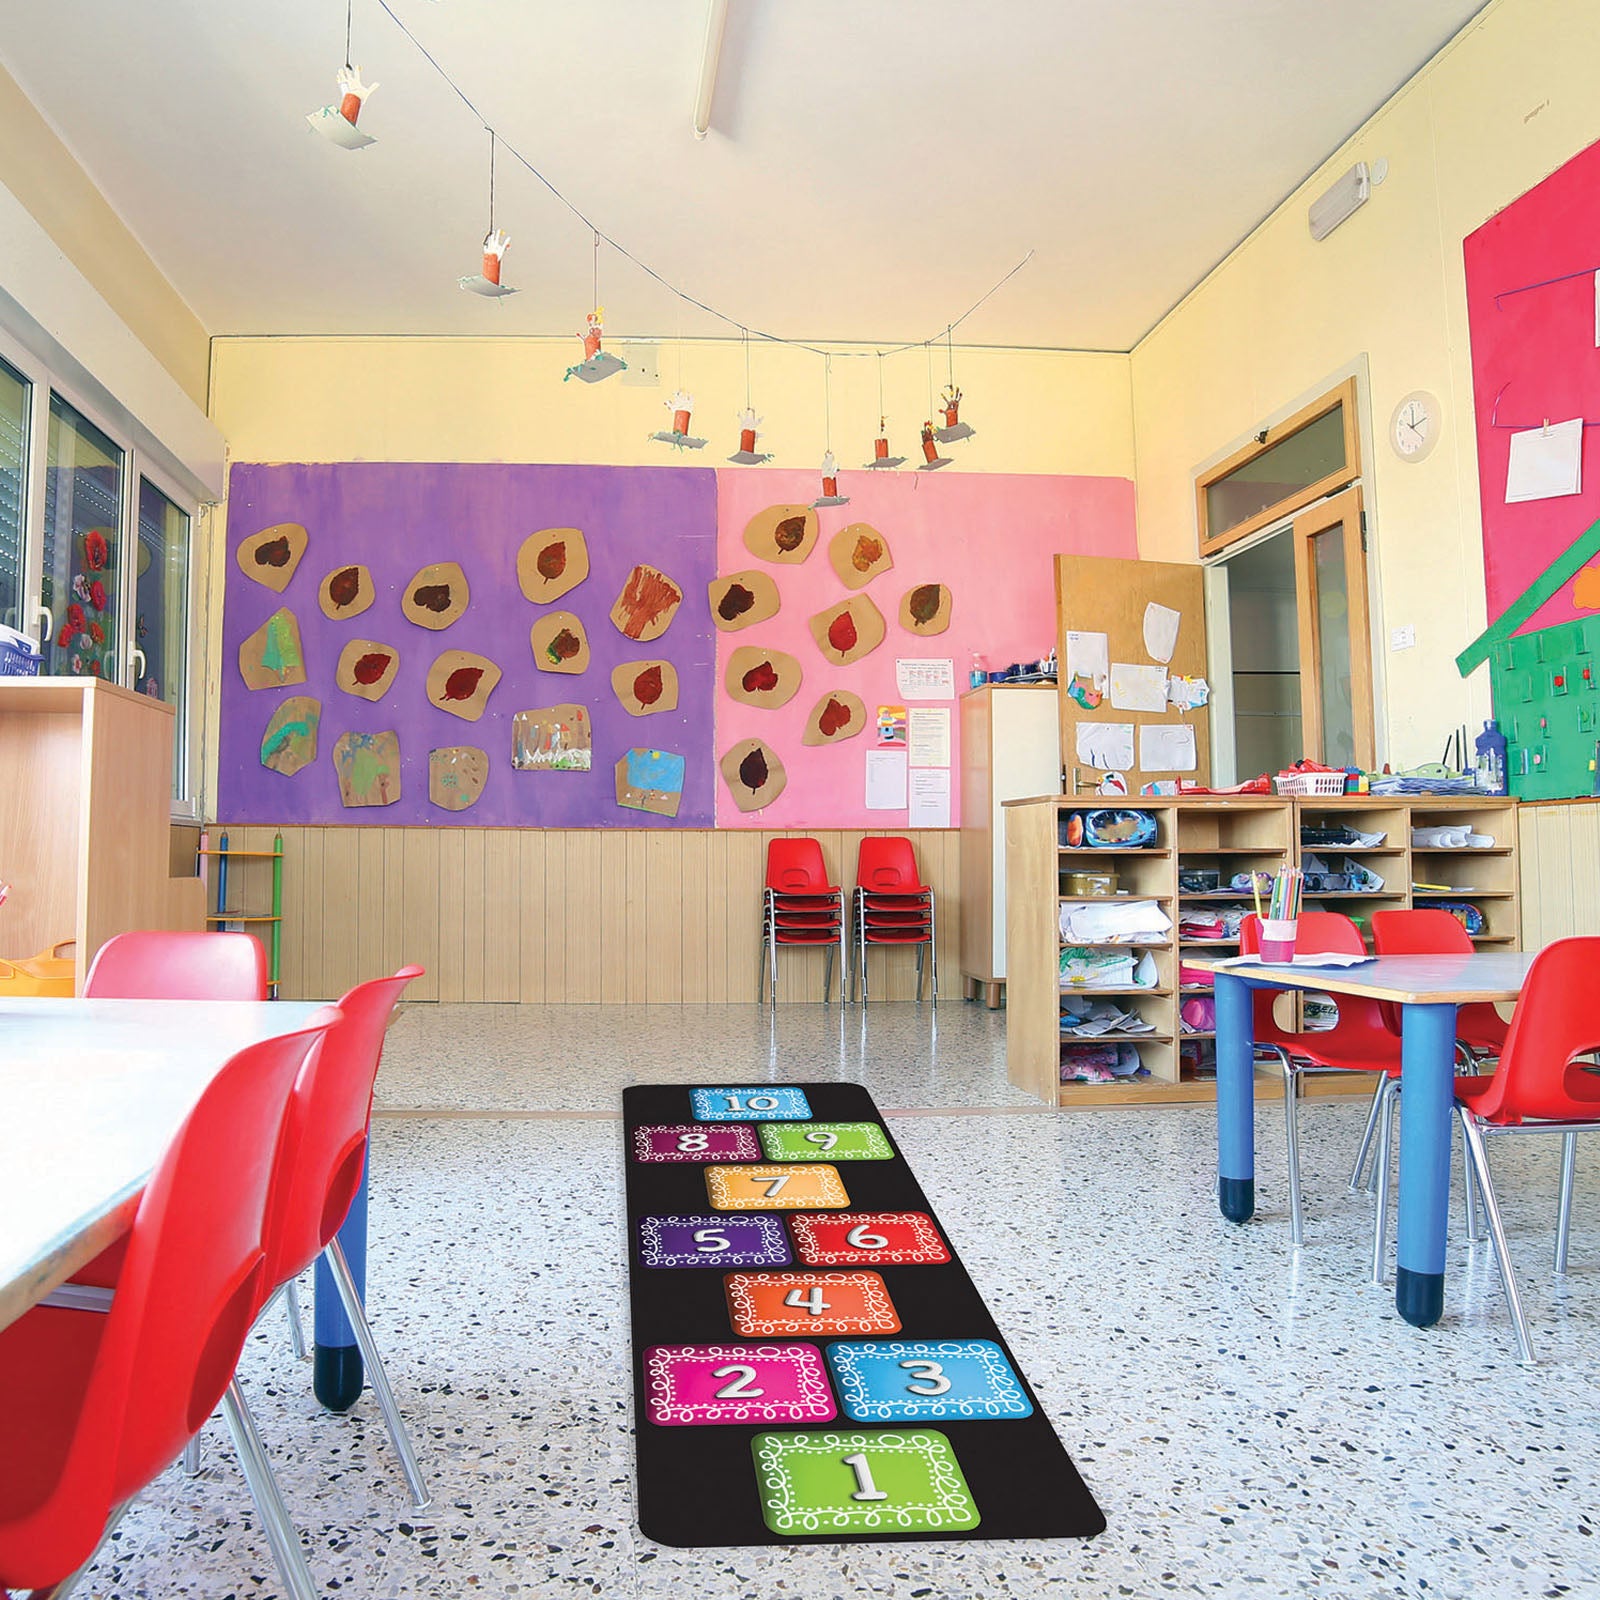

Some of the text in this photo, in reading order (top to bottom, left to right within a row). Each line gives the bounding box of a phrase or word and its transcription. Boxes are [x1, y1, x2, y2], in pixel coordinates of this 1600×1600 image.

[725, 1096, 779, 1111] 10
[677, 1133, 709, 1152] 8
[806, 1131, 838, 1151] 9
[752, 1175, 791, 1197] 7
[693, 1228, 730, 1252] 5
[847, 1224, 888, 1249] 6
[784, 1287, 830, 1315] 4
[713, 1364, 763, 1398] 2
[900, 1360, 951, 1396] 3
[843, 1453, 888, 1500] 1
